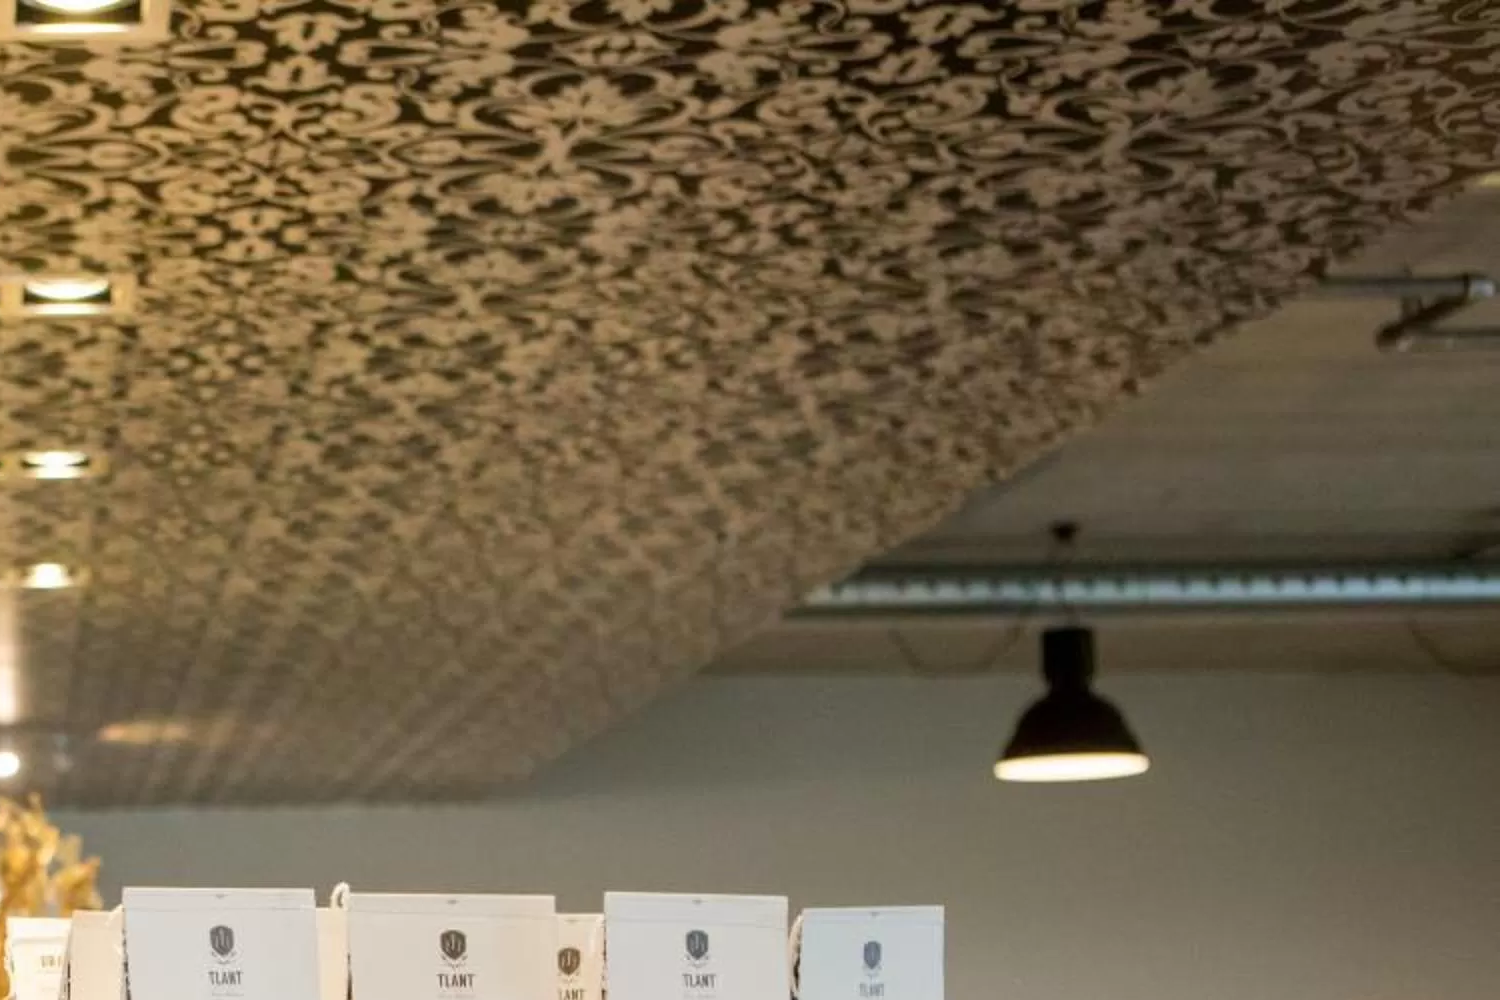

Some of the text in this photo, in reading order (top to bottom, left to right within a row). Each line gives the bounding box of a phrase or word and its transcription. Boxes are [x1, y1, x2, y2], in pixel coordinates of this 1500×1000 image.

[208, 971, 243, 985] TLANT
[437, 973, 476, 988] TLANT
[682, 974, 716, 989] TLANT
